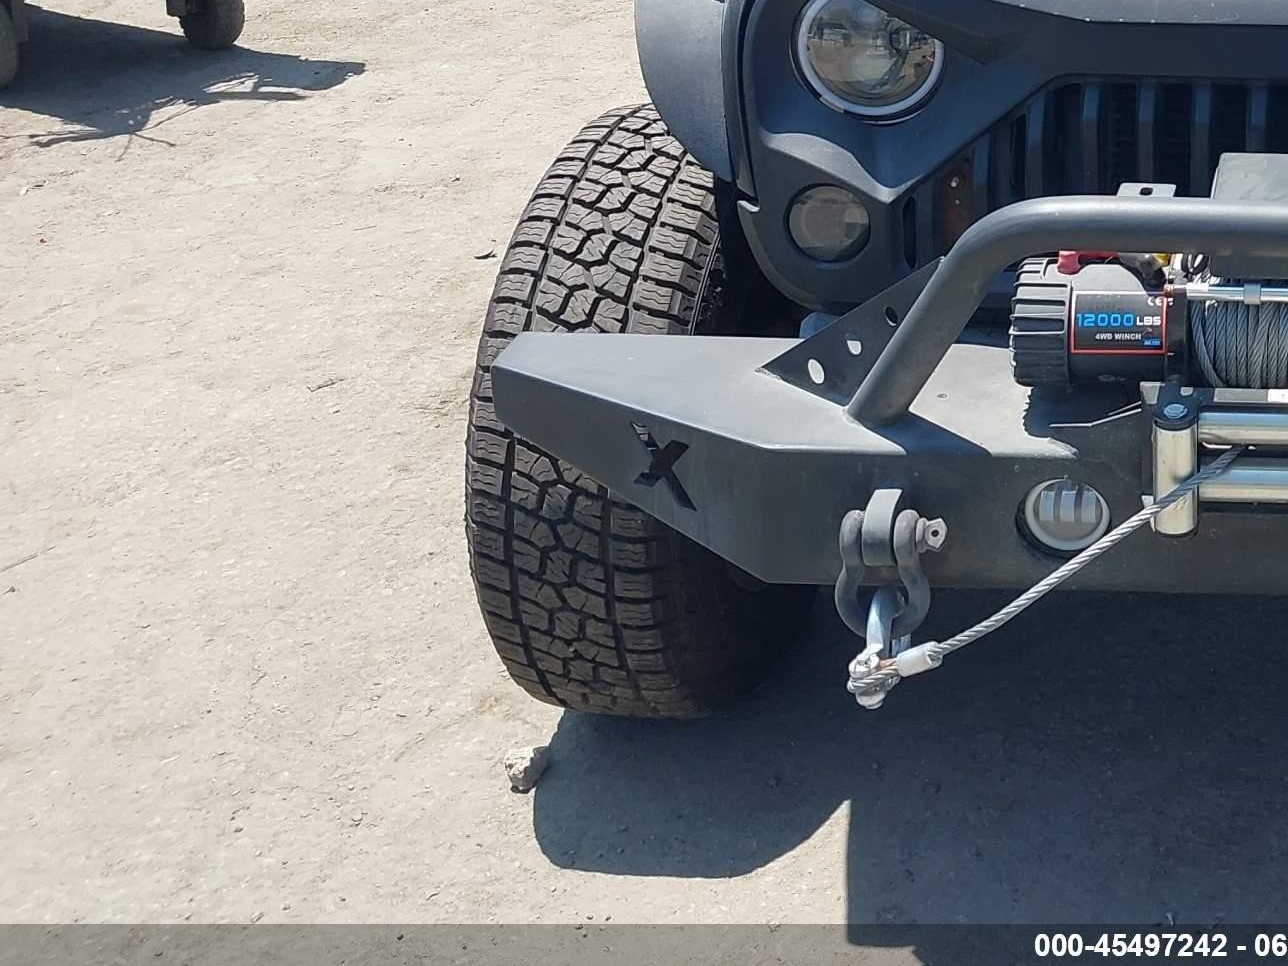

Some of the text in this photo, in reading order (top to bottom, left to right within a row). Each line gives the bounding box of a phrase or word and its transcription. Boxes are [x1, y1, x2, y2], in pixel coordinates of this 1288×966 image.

[1076, 313, 1162, 327] 12000 LBS
[1095, 333, 1142, 341] 4WD WINCH
